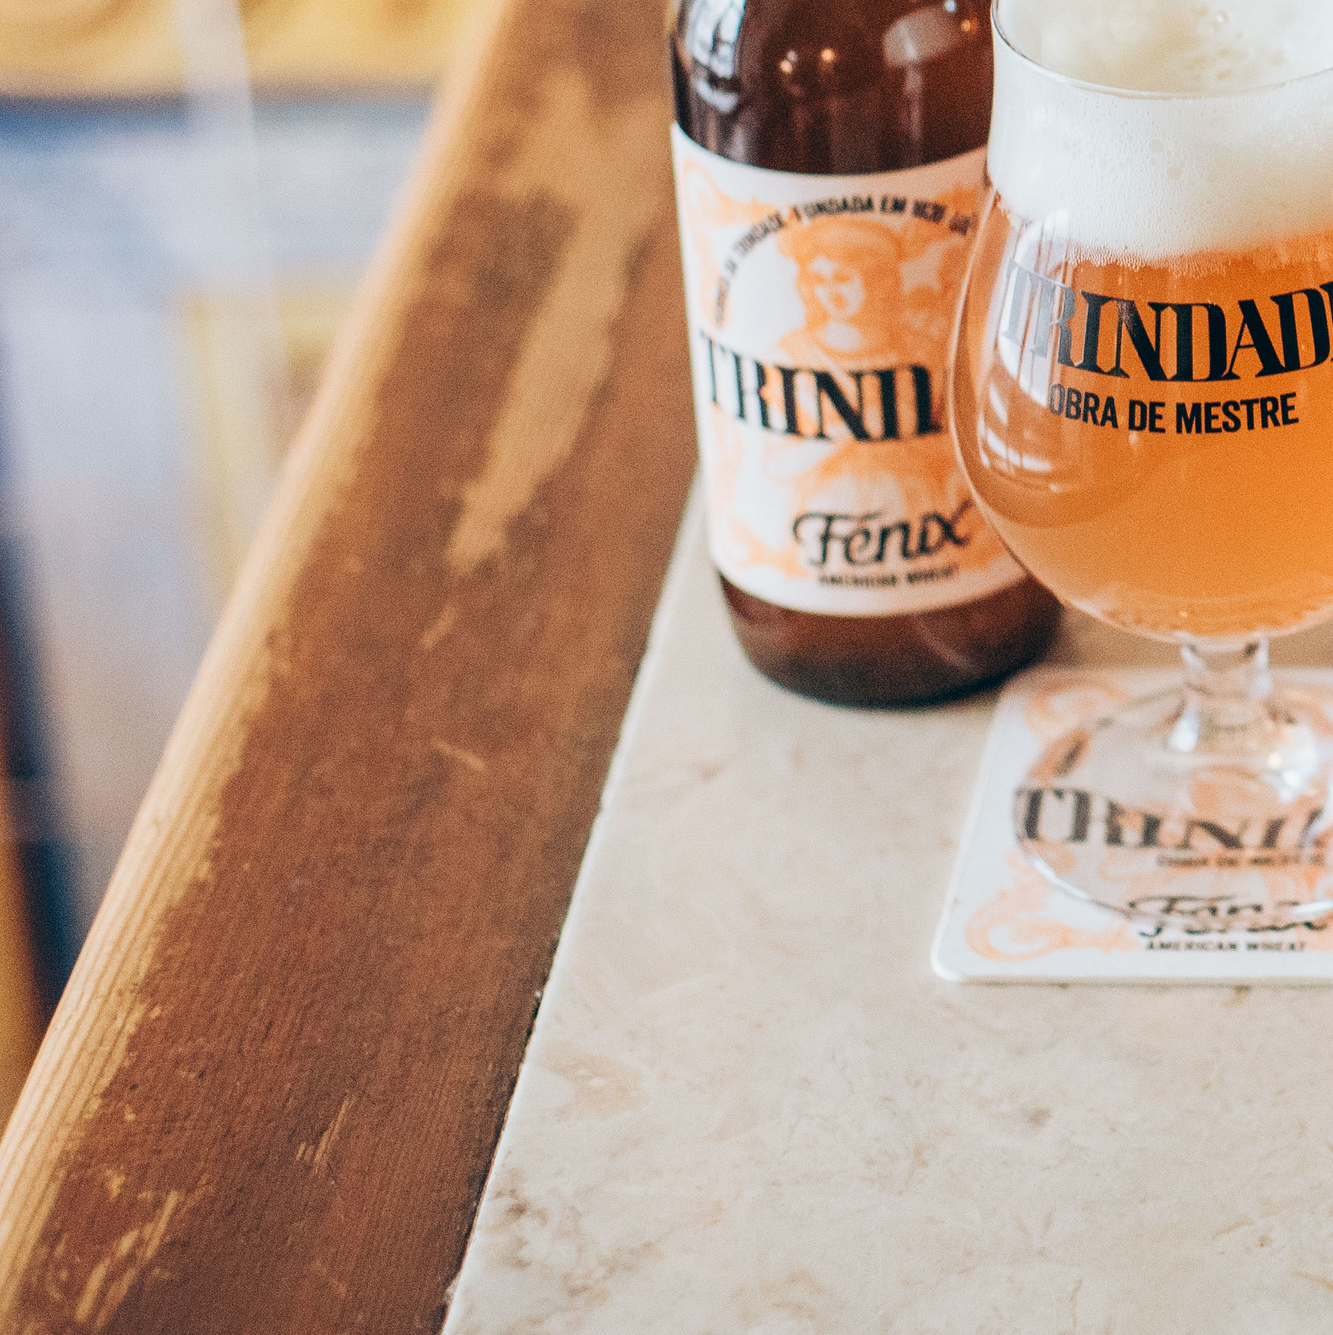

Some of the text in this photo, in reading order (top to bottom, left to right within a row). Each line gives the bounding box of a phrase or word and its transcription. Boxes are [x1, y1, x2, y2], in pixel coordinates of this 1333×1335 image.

[700, 329, 944, 443] TRIND
[1050, 383, 1300, 434] OBRA DE MESTRE
